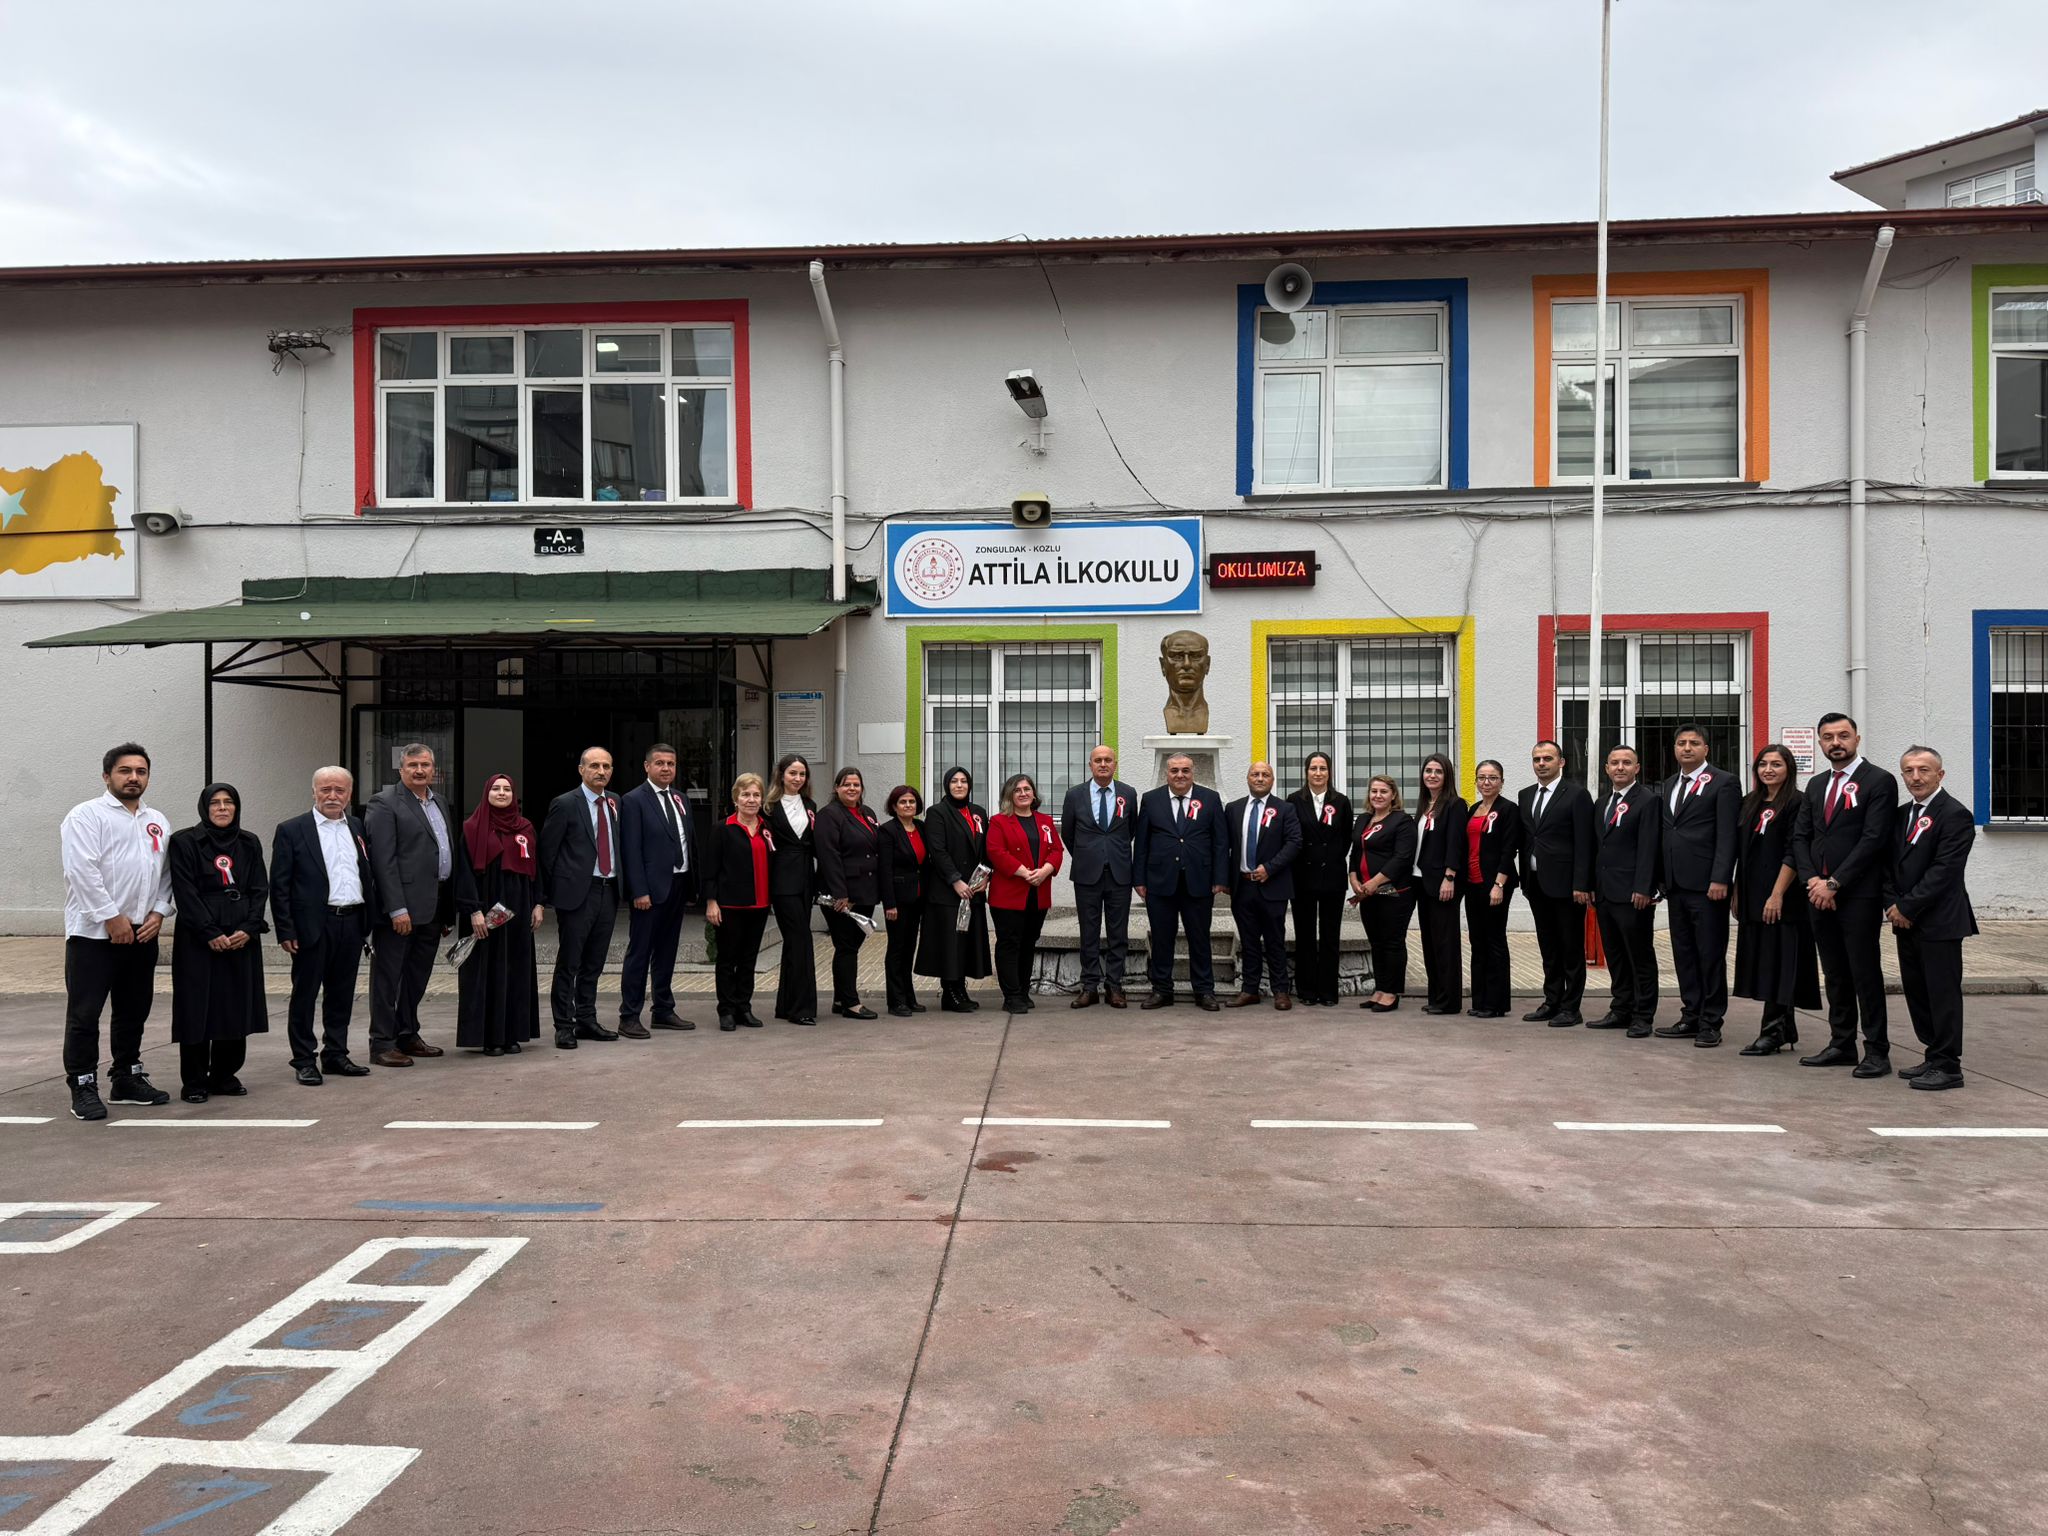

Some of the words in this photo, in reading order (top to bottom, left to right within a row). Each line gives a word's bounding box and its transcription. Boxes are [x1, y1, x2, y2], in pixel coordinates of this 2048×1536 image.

[540, 545, 576, 553] BLOK
[975, 546, 1026, 554] ZONGULDAK
[1033, 545, 1061, 553] KOZLU
[968, 557, 1051, 586] ATTİLA
[1057, 556, 1179, 585] İLKOKULU
[1218, 561, 1306, 578] OKULUMUZA
